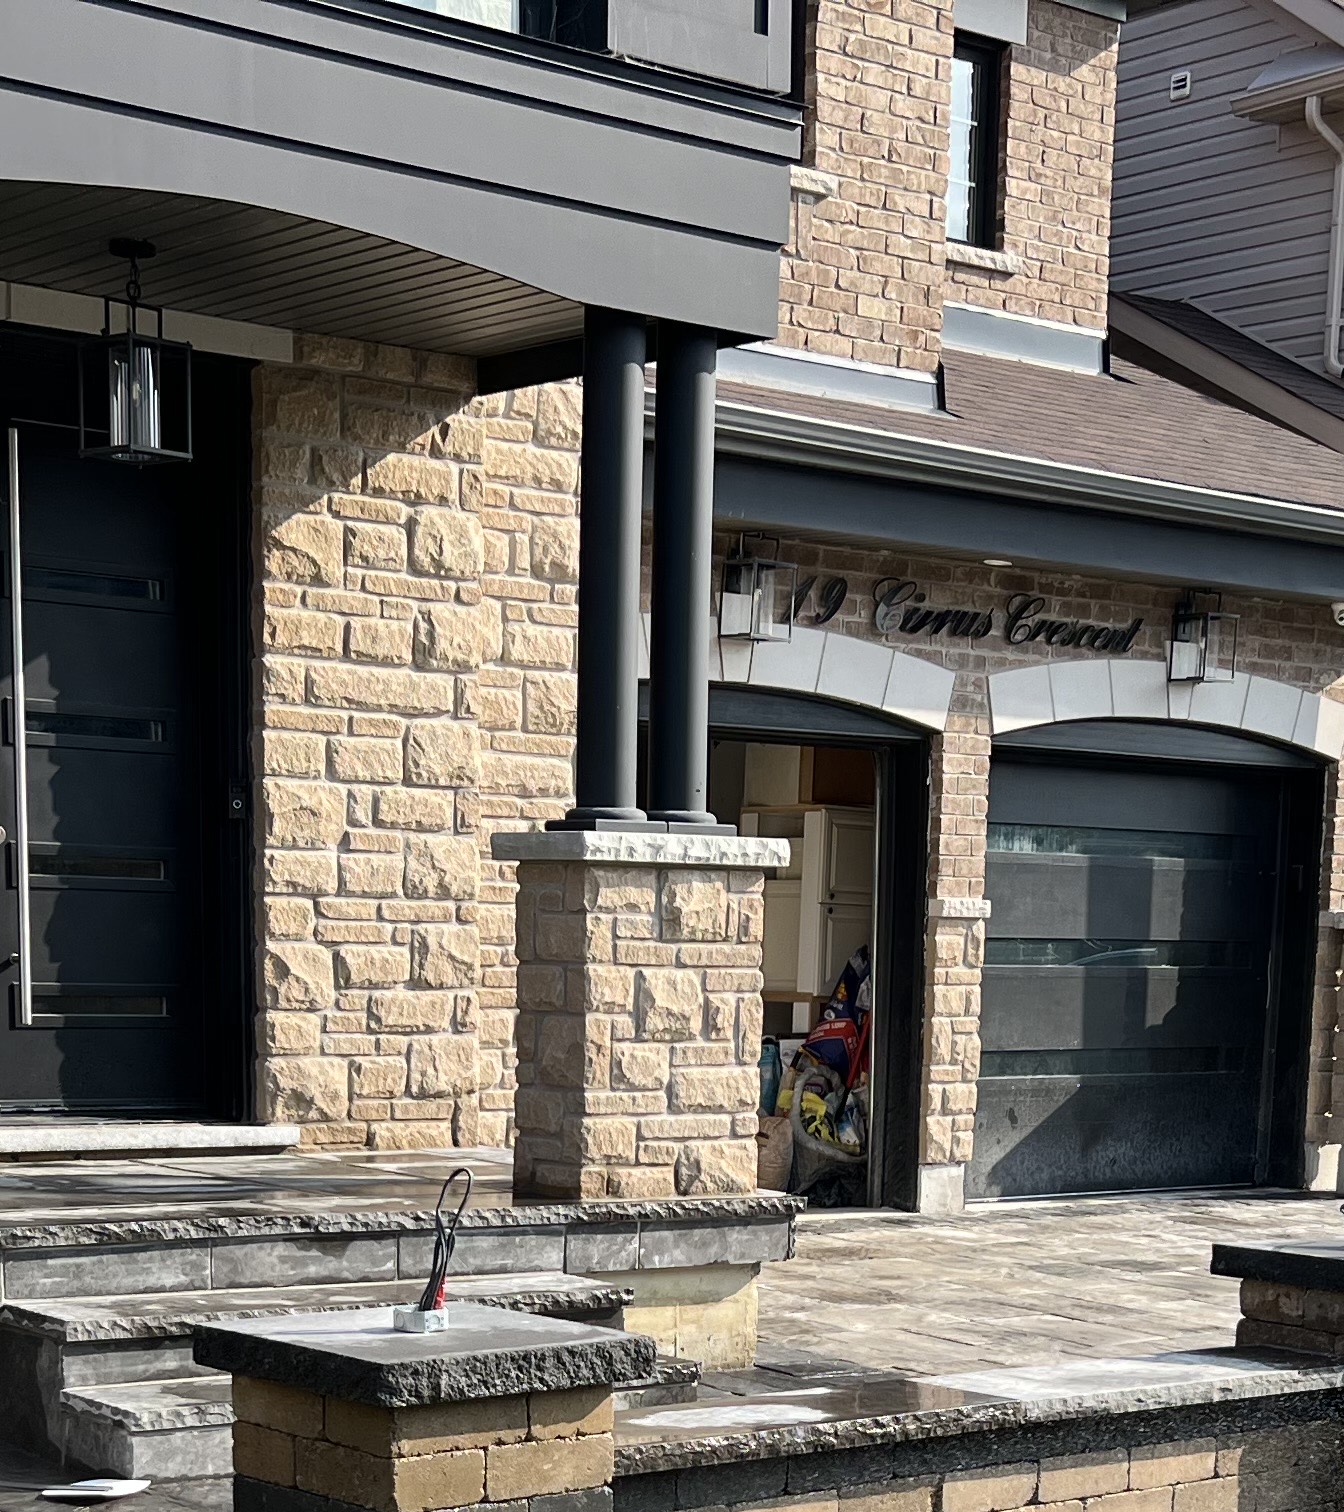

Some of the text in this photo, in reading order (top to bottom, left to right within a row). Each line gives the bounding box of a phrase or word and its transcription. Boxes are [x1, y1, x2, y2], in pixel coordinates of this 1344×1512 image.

[782, 575, 1144, 653] 19 Cirrus Crescent
